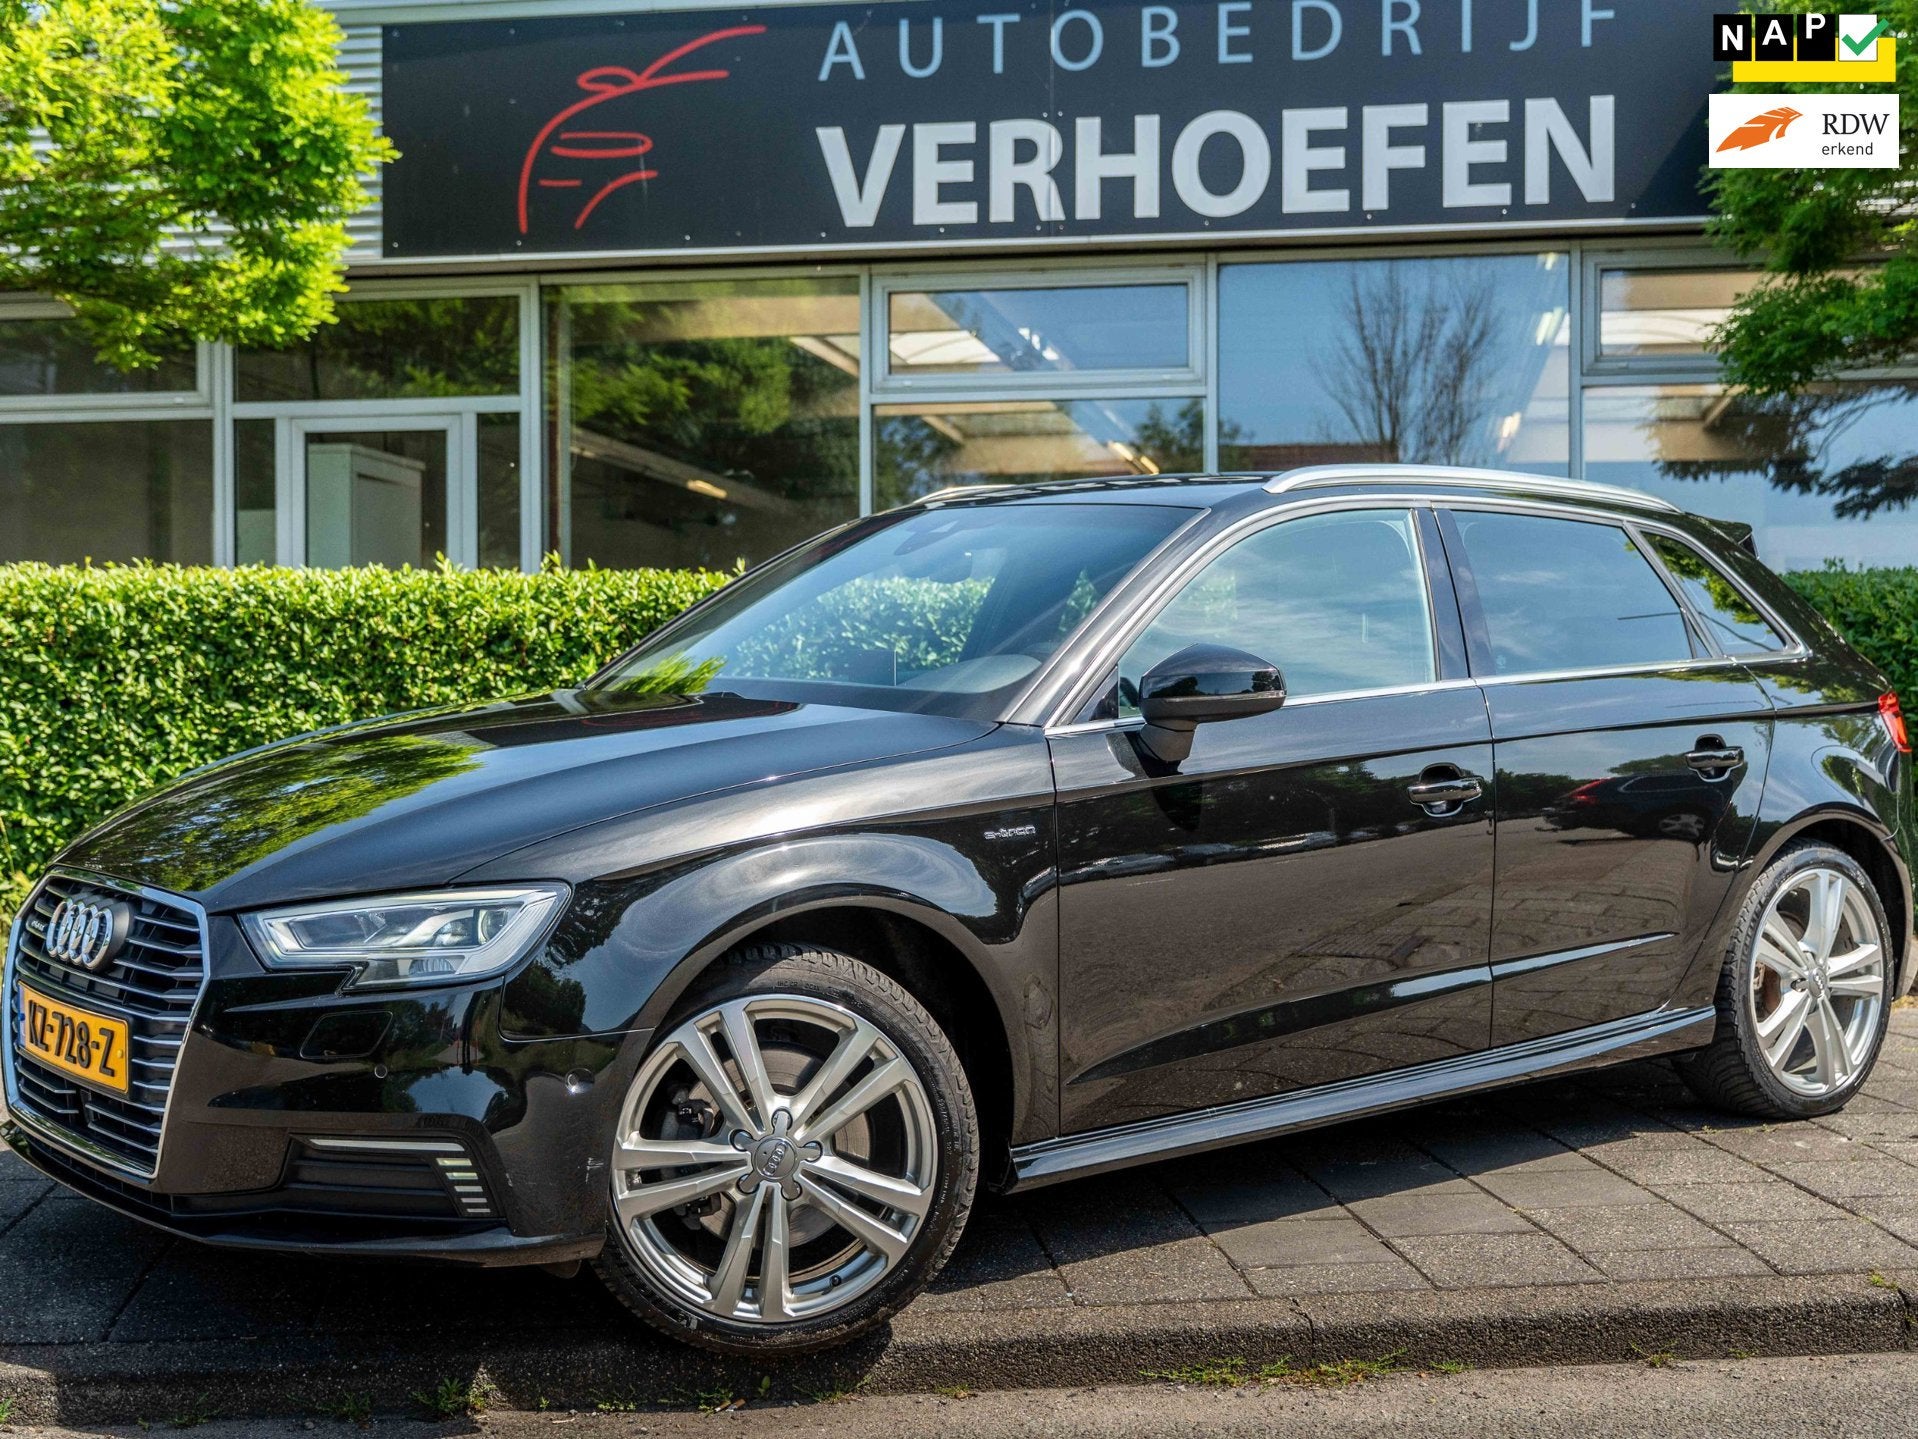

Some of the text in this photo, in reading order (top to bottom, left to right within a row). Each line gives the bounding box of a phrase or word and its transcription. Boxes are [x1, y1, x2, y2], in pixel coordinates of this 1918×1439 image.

[818, 0, 1616, 82] AUTOBEDRIJF
[816, 94, 1616, 228] VERHOEFEN
[28, 1000, 115, 1077] KZ-728-Z
